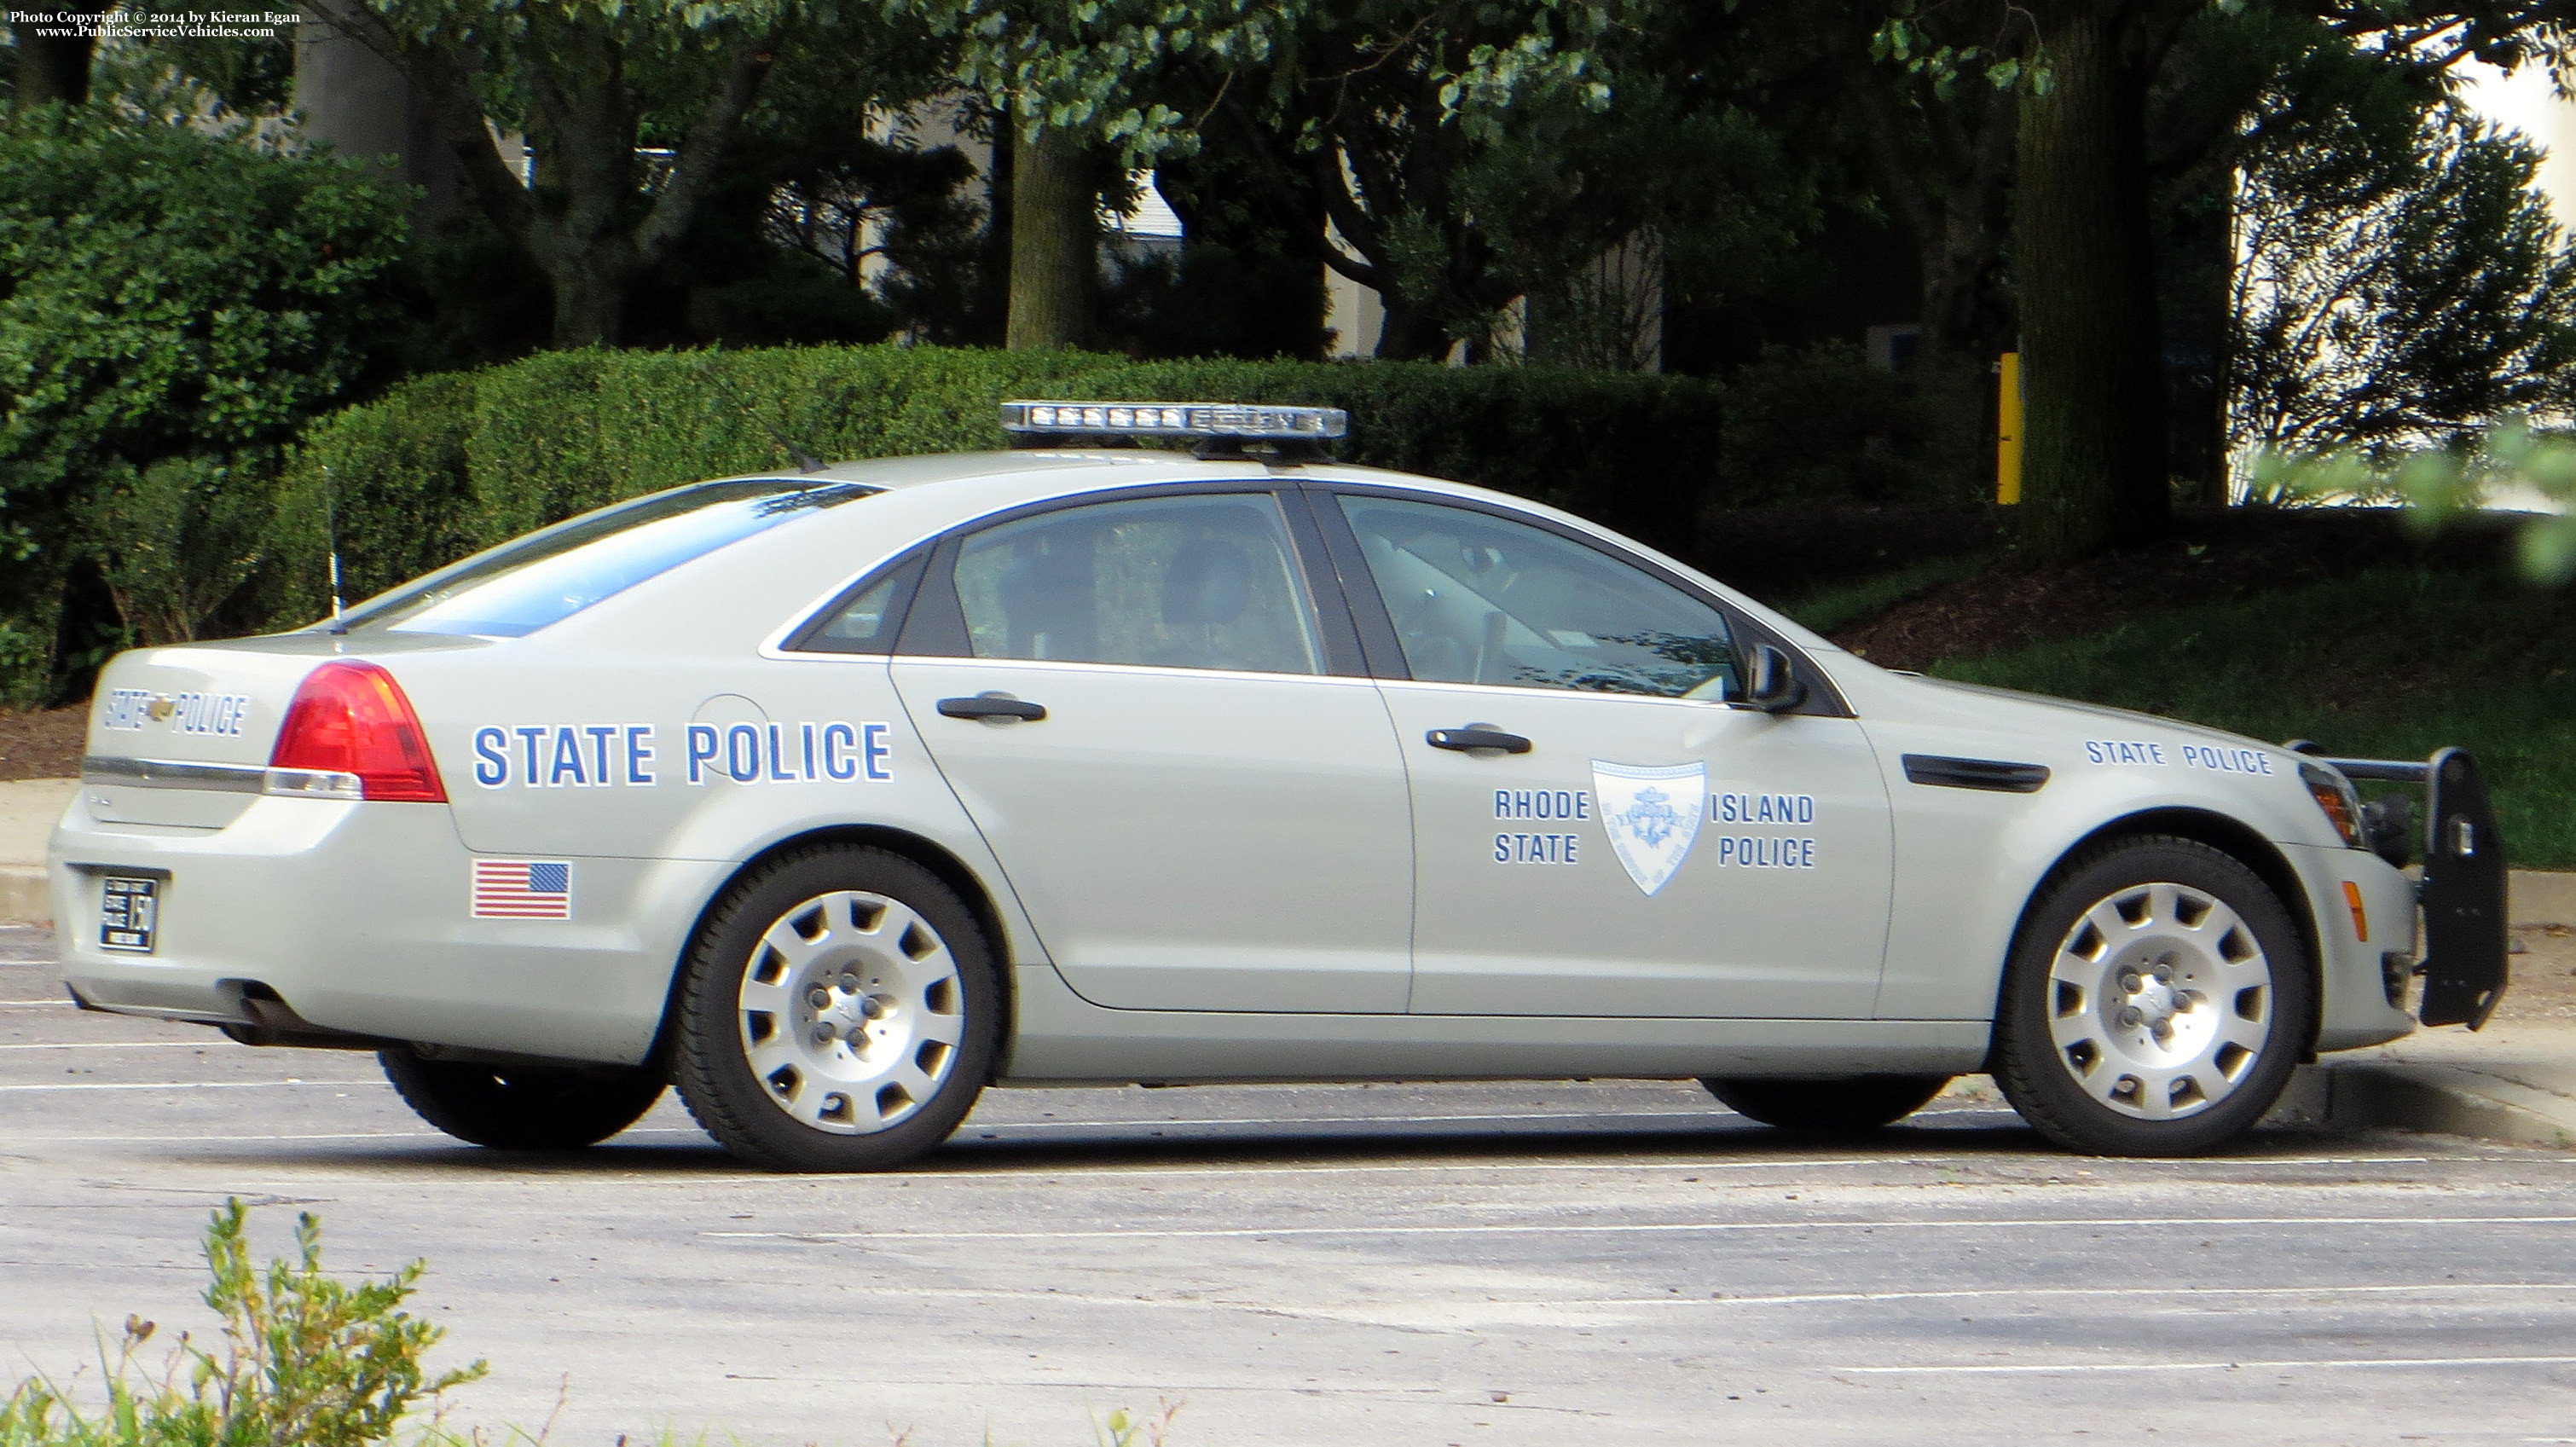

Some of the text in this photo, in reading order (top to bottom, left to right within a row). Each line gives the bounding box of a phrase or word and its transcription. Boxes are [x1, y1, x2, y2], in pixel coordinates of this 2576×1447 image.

[105, 689, 249, 738] STATE POLICE
[473, 721, 894, 789] STATE POLICE
[2085, 740, 2274, 777] STATE POLICE
[1494, 789, 1815, 825] RHODE ISLAND
[1494, 833, 1815, 869] STATE POLICE
